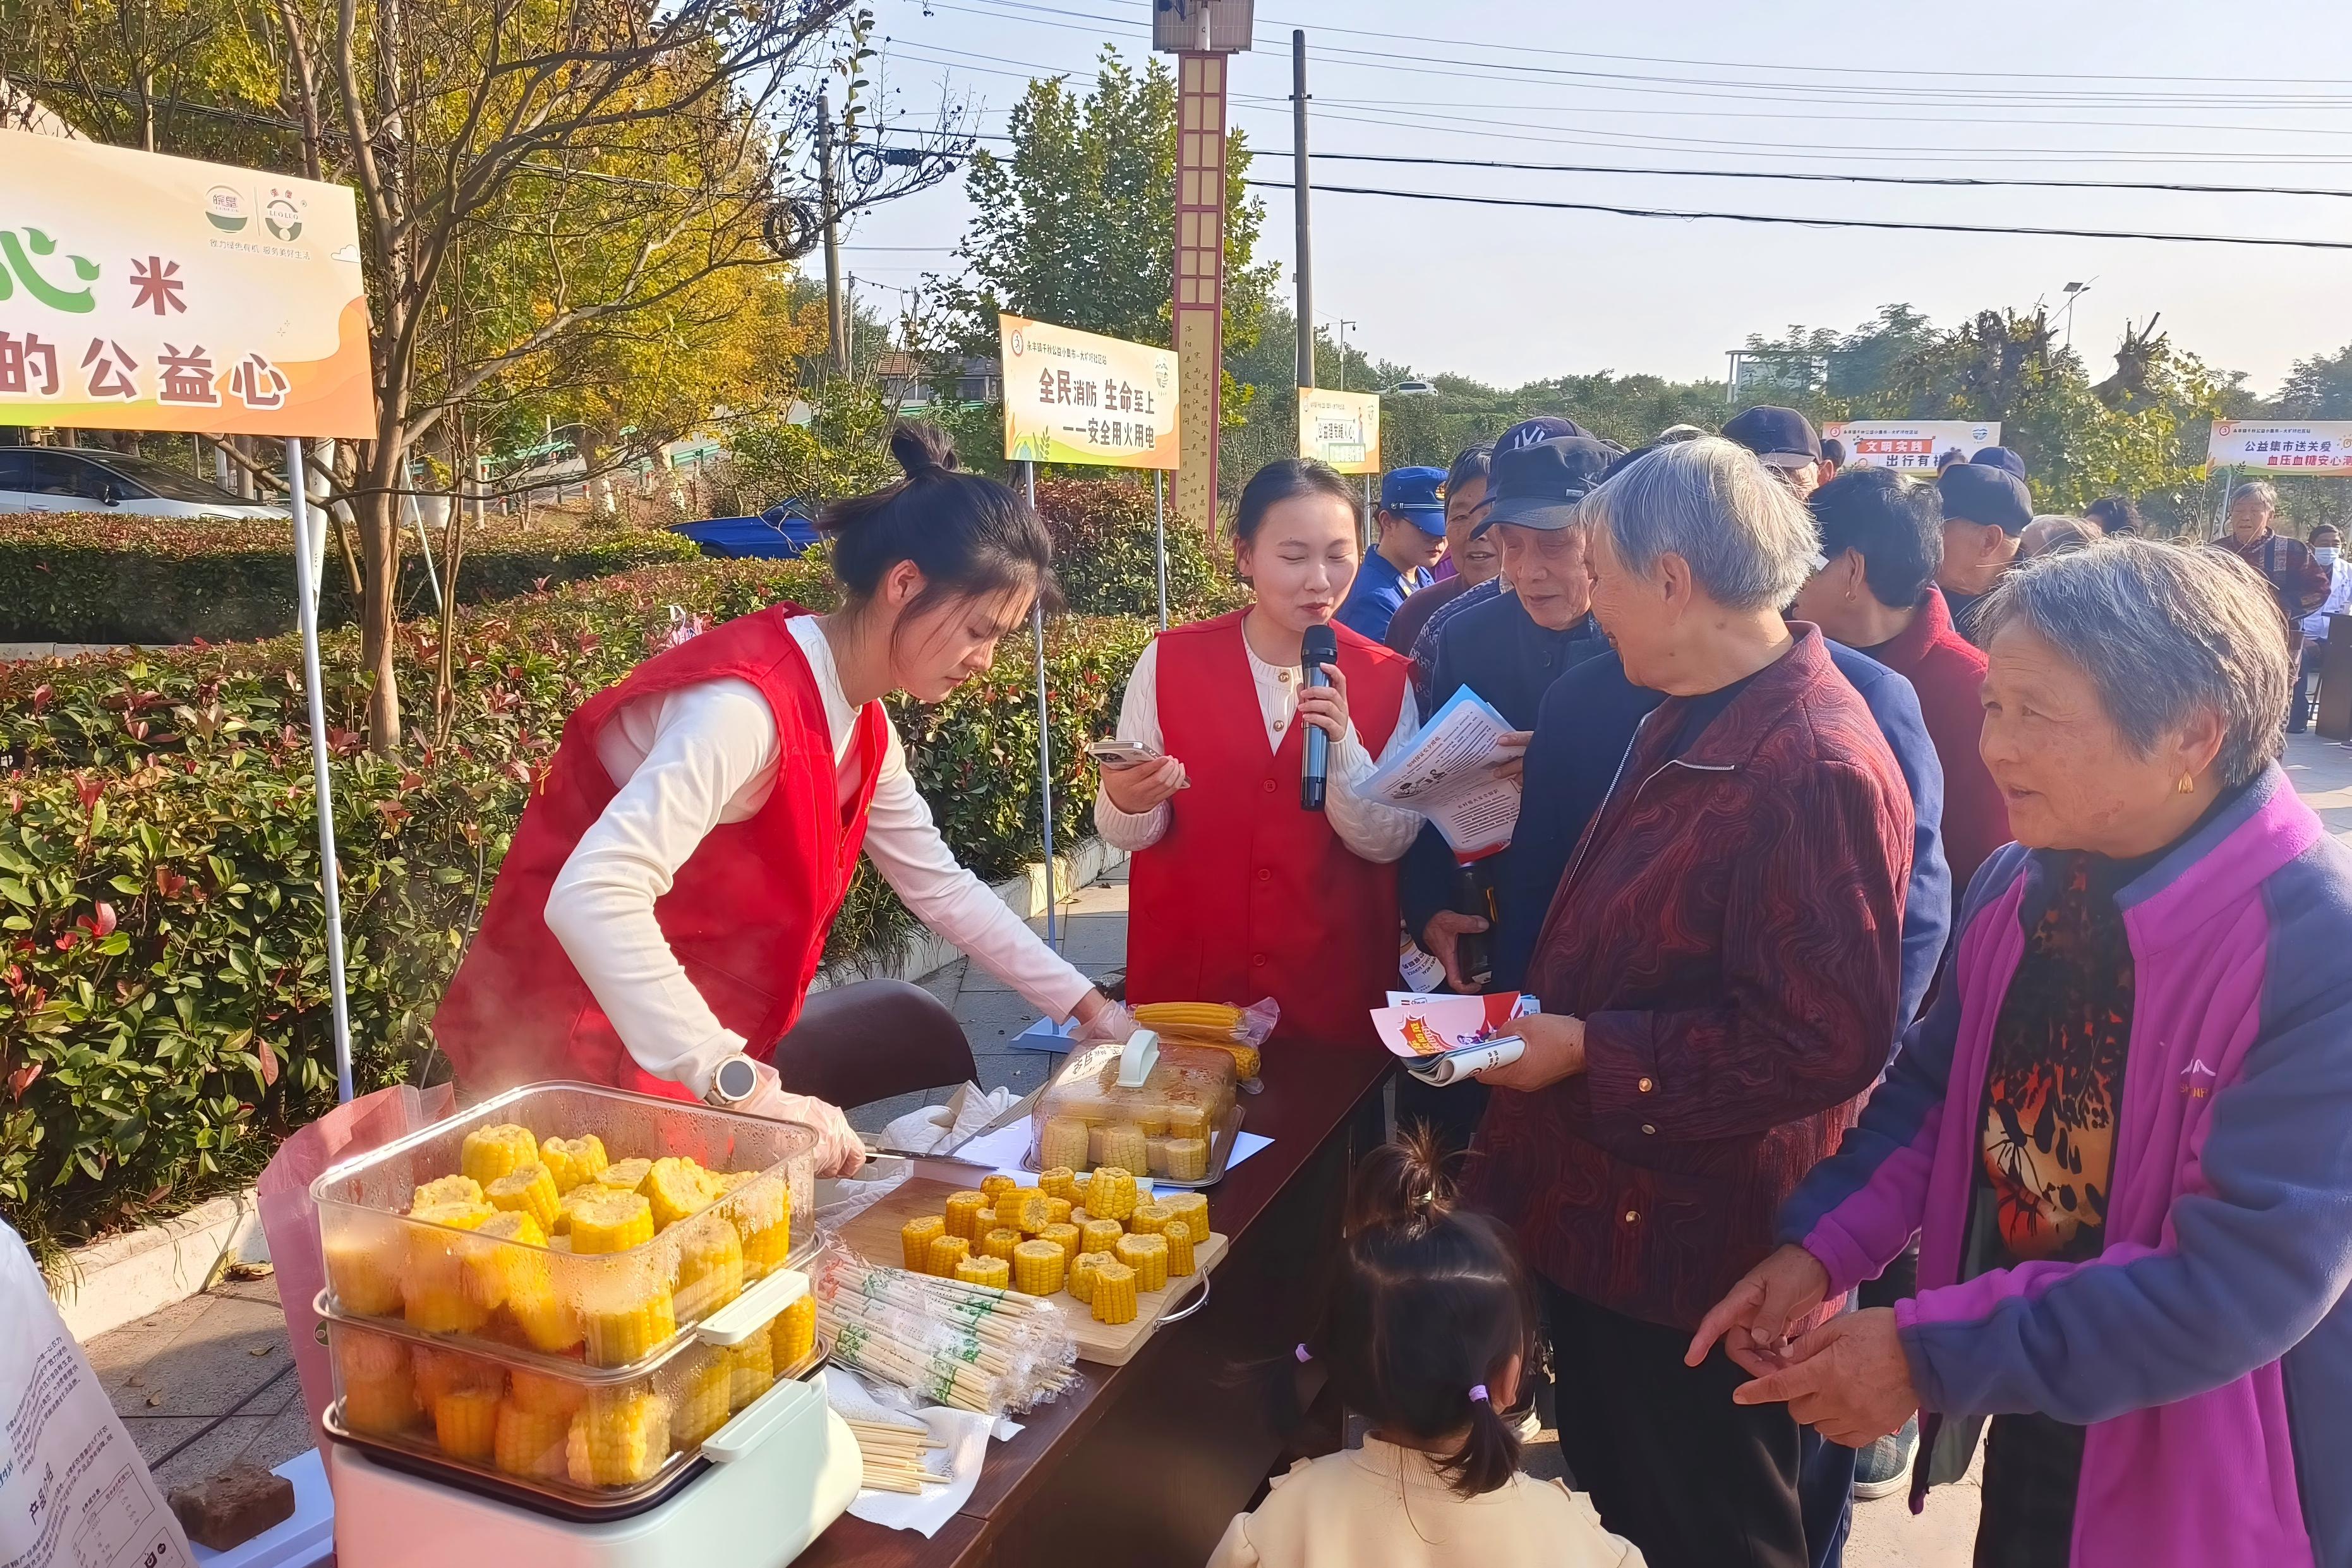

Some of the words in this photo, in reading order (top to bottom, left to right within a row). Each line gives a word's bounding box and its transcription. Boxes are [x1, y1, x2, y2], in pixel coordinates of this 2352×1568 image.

[130, 256, 188, 316] 米
[0, 331, 287, 406] 的公益心
[1039, 367, 1097, 408] 全民消防
[1104, 378, 1155, 414] 生命至上
[1865, 440, 1922, 452] 文明实践
[2245, 440, 2331, 452] 公益集市送关爱
